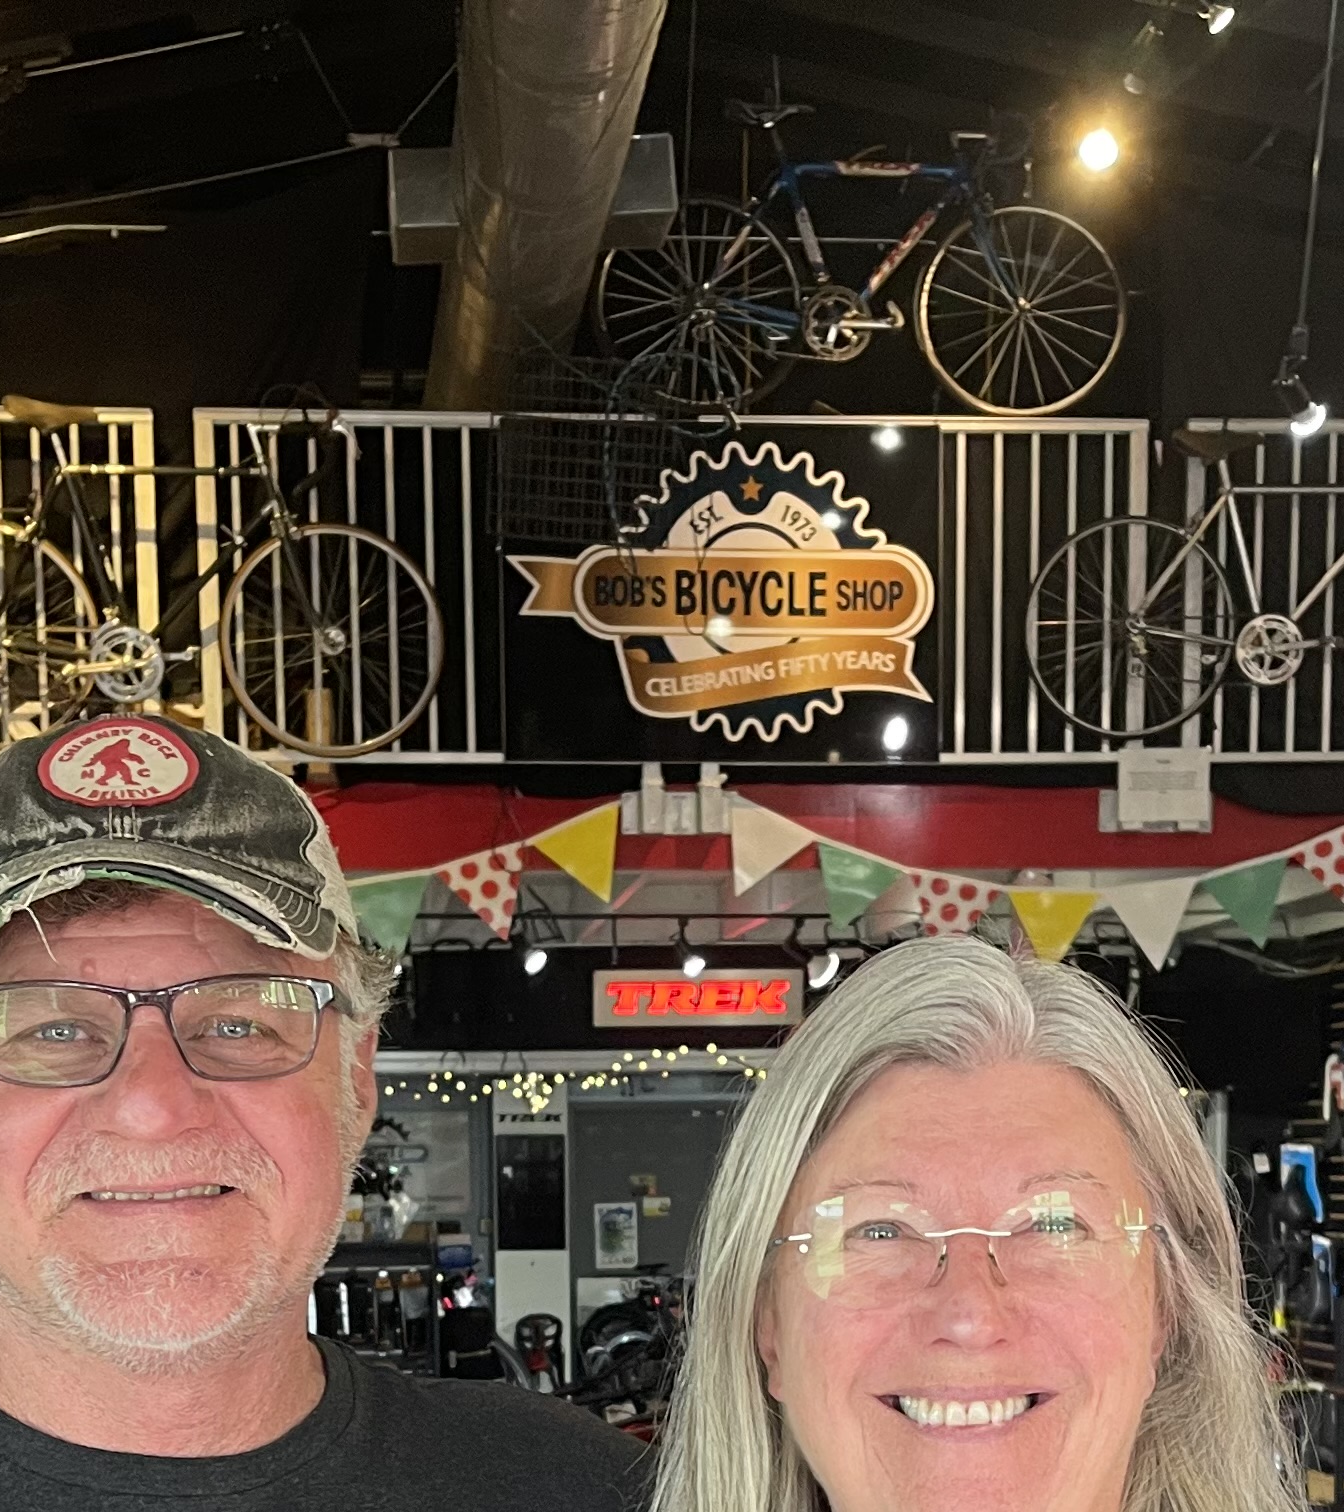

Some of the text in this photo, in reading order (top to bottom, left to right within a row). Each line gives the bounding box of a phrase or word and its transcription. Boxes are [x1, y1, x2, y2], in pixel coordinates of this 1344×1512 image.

[780, 505, 817, 541] 1973
[594, 569, 904, 616] BOB'S BICYCLE SHOP
[645, 651, 896, 697] CELEBRATING FIFTY YEARS
[137, 733, 178, 760] ROCK
[87, 786, 162, 799] BELIEVE
[607, 981, 791, 1015] TREK
